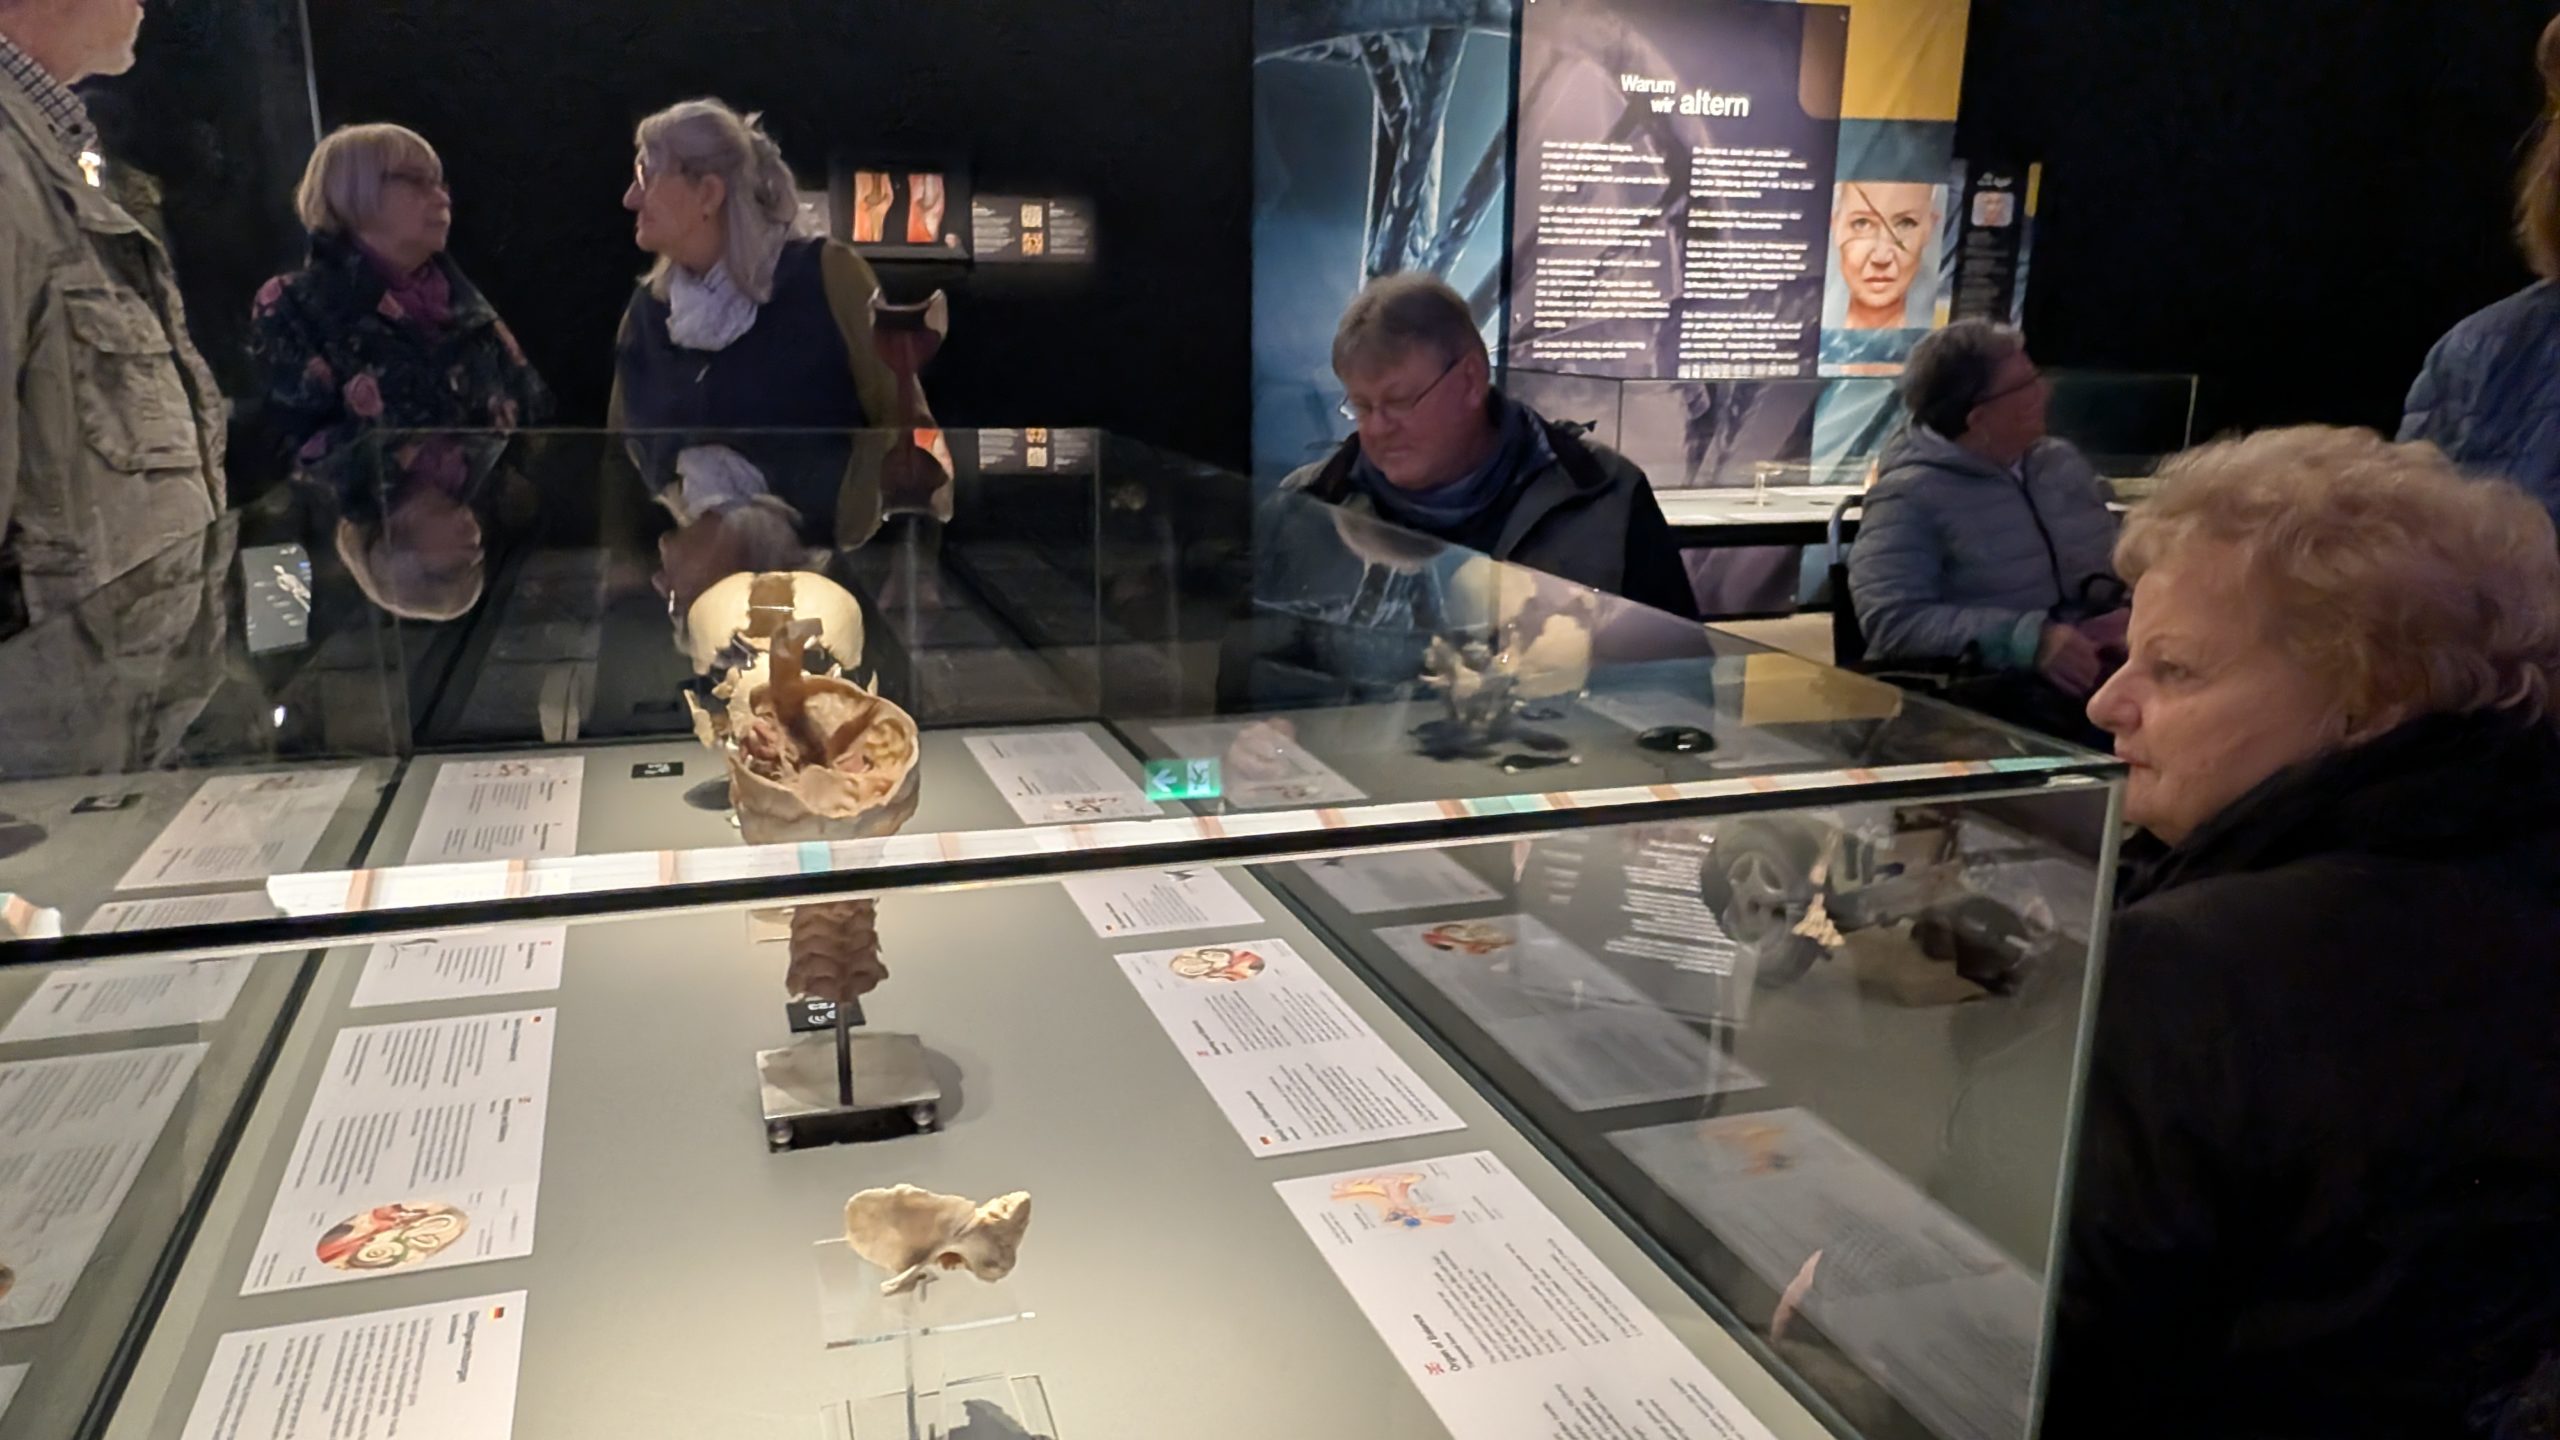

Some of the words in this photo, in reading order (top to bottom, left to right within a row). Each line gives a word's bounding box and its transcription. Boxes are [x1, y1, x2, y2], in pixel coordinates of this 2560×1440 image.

[1620, 73, 1676, 94] Warum
[1650, 96, 1676, 114] wir
[1679, 88, 1750, 117] altern
[1413, 1313, 1437, 1340] Balance
[1440, 1349, 1461, 1371] Organ
